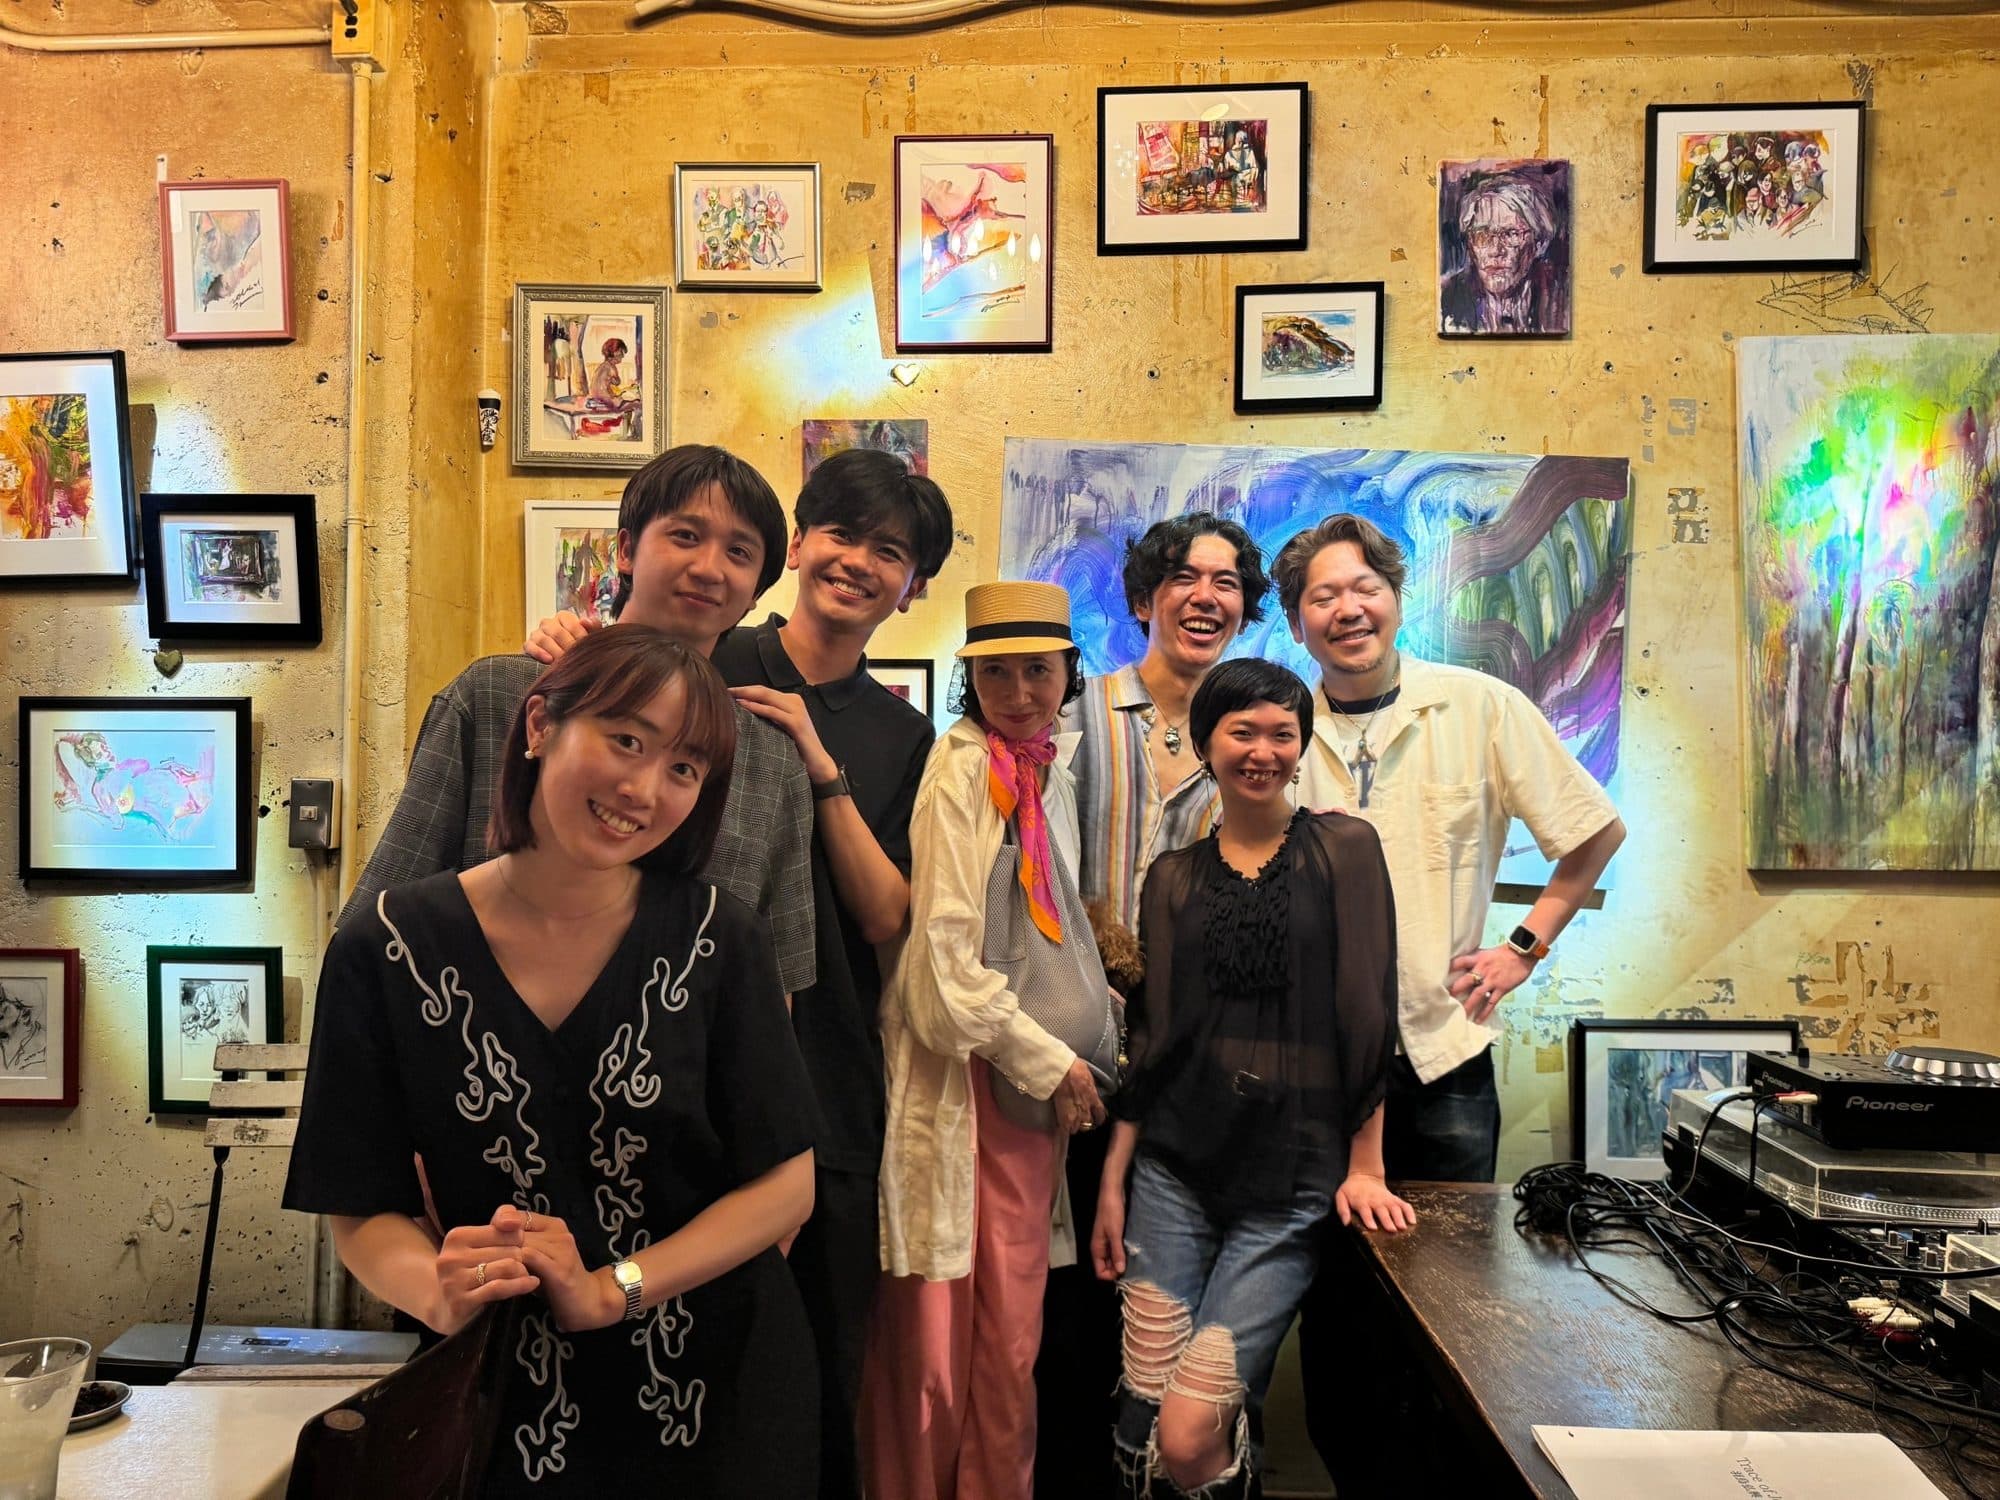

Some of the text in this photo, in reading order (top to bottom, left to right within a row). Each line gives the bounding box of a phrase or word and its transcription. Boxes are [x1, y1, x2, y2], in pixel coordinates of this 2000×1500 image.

[1845, 1096, 1934, 1112] Pioneer
[1736, 1457, 1762, 1482] Trace
[1758, 1484, 1778, 1495] of
